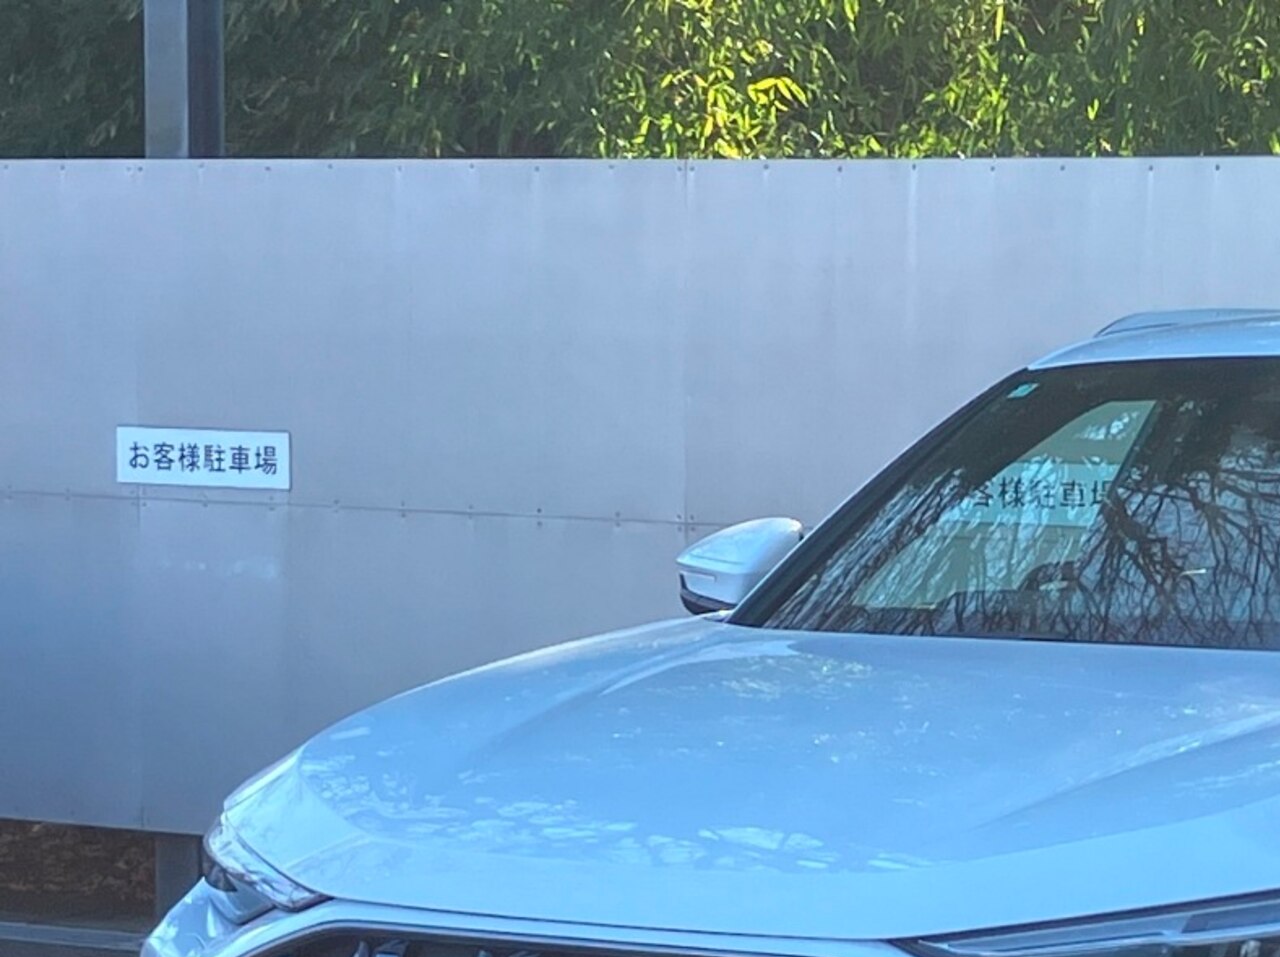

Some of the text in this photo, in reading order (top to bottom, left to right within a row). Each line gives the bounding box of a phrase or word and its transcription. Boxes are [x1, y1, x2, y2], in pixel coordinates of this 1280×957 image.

[128, 440, 278, 476] お客様駐車場
